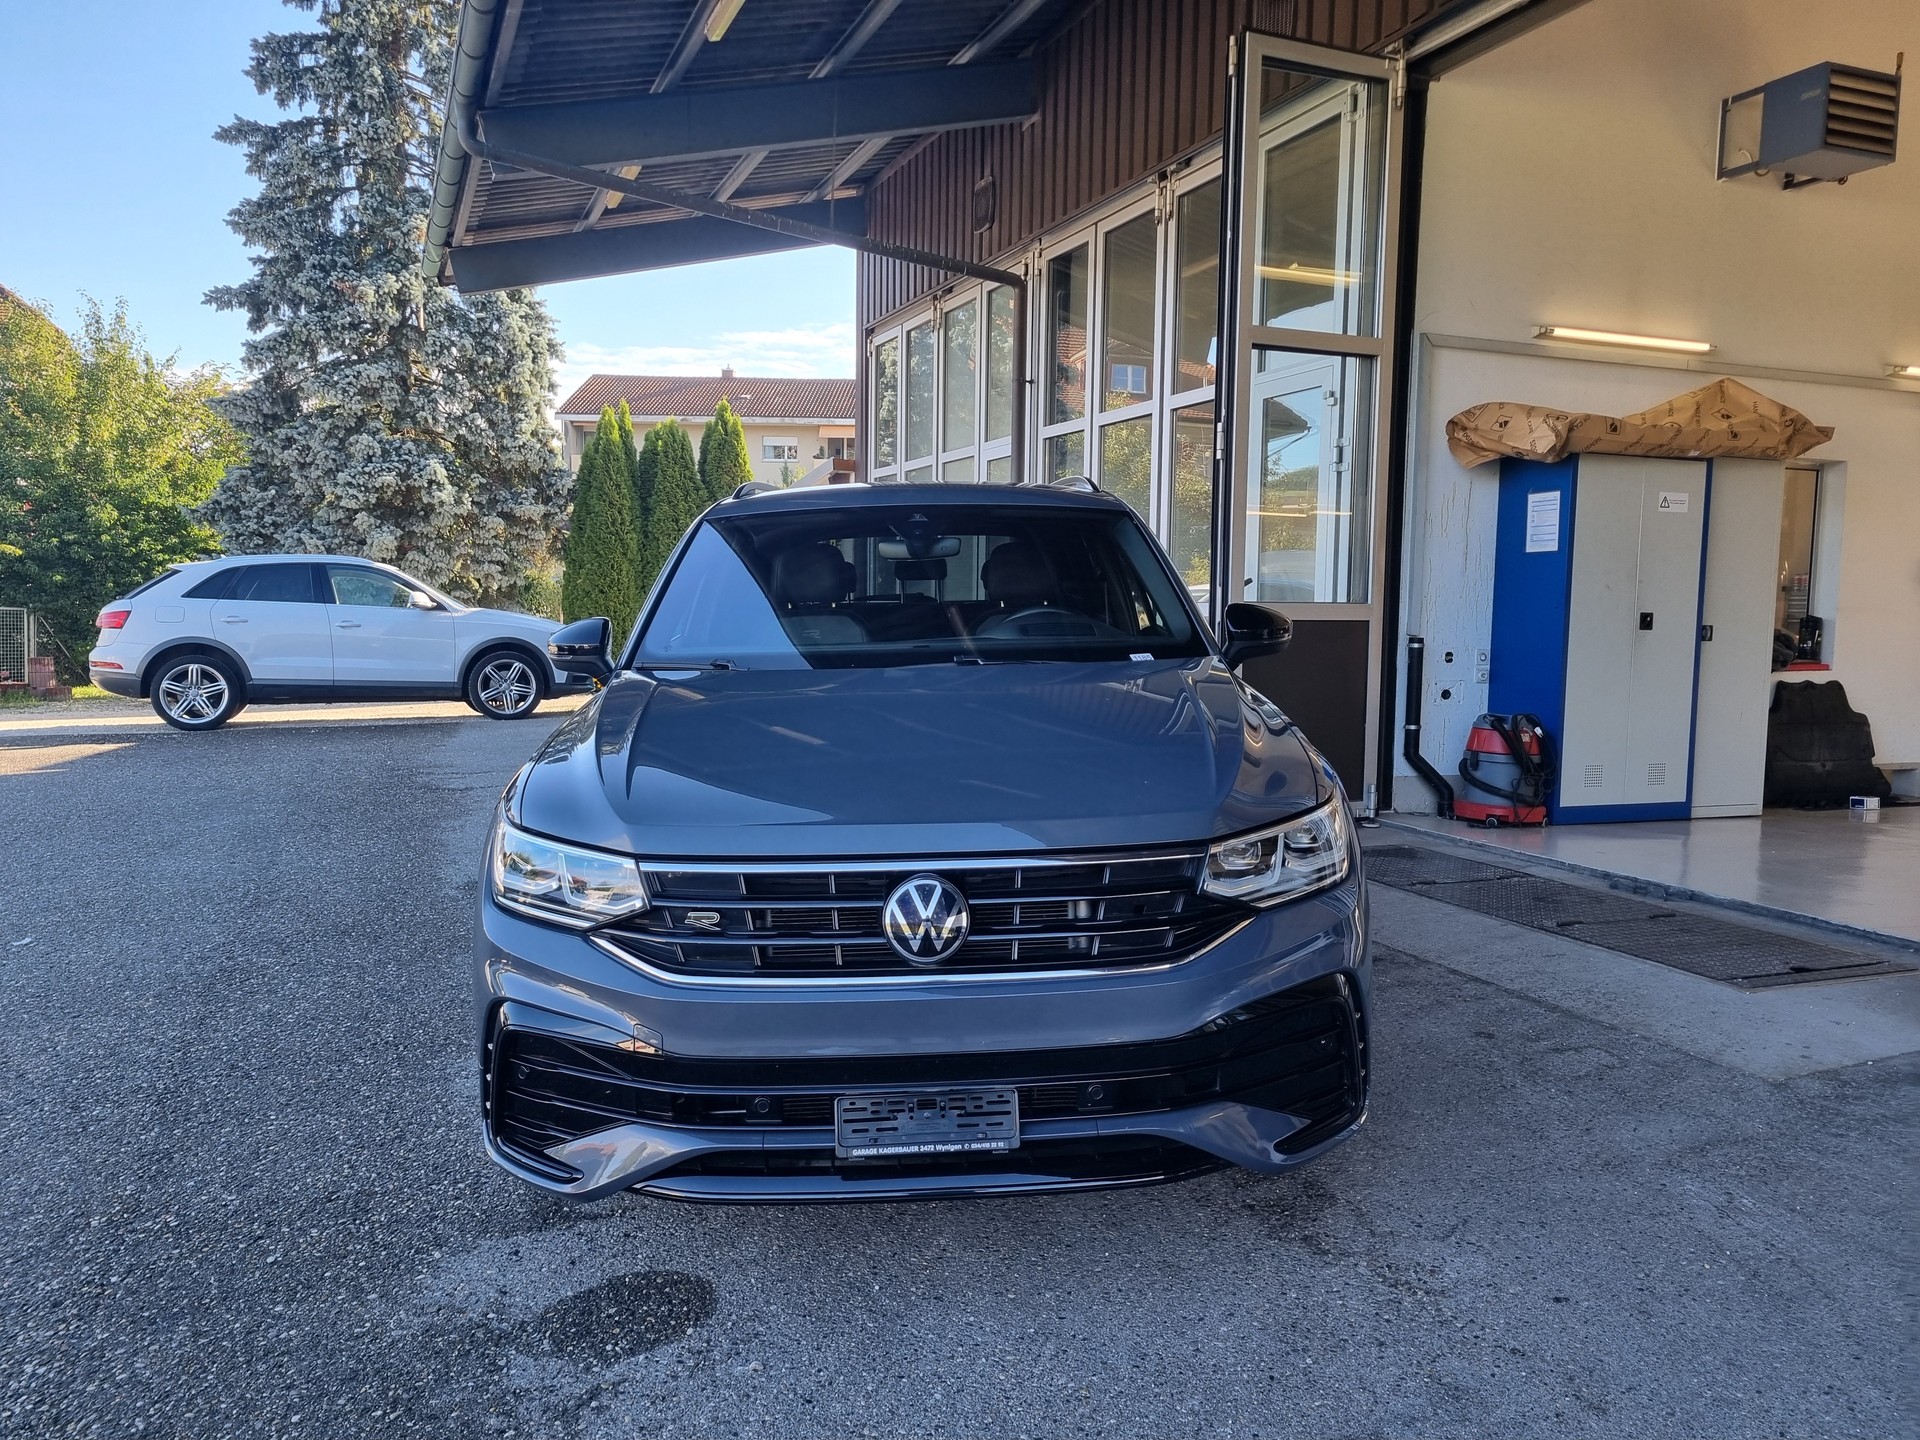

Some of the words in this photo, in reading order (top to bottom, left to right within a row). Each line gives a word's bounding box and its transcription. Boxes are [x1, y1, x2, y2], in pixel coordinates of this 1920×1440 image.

[685, 912, 721, 931] R
[852, 1147, 878, 1156] GARAGE
[919, 1144, 935, 1152] 3472
[935, 1143, 962, 1152] Wynigen
